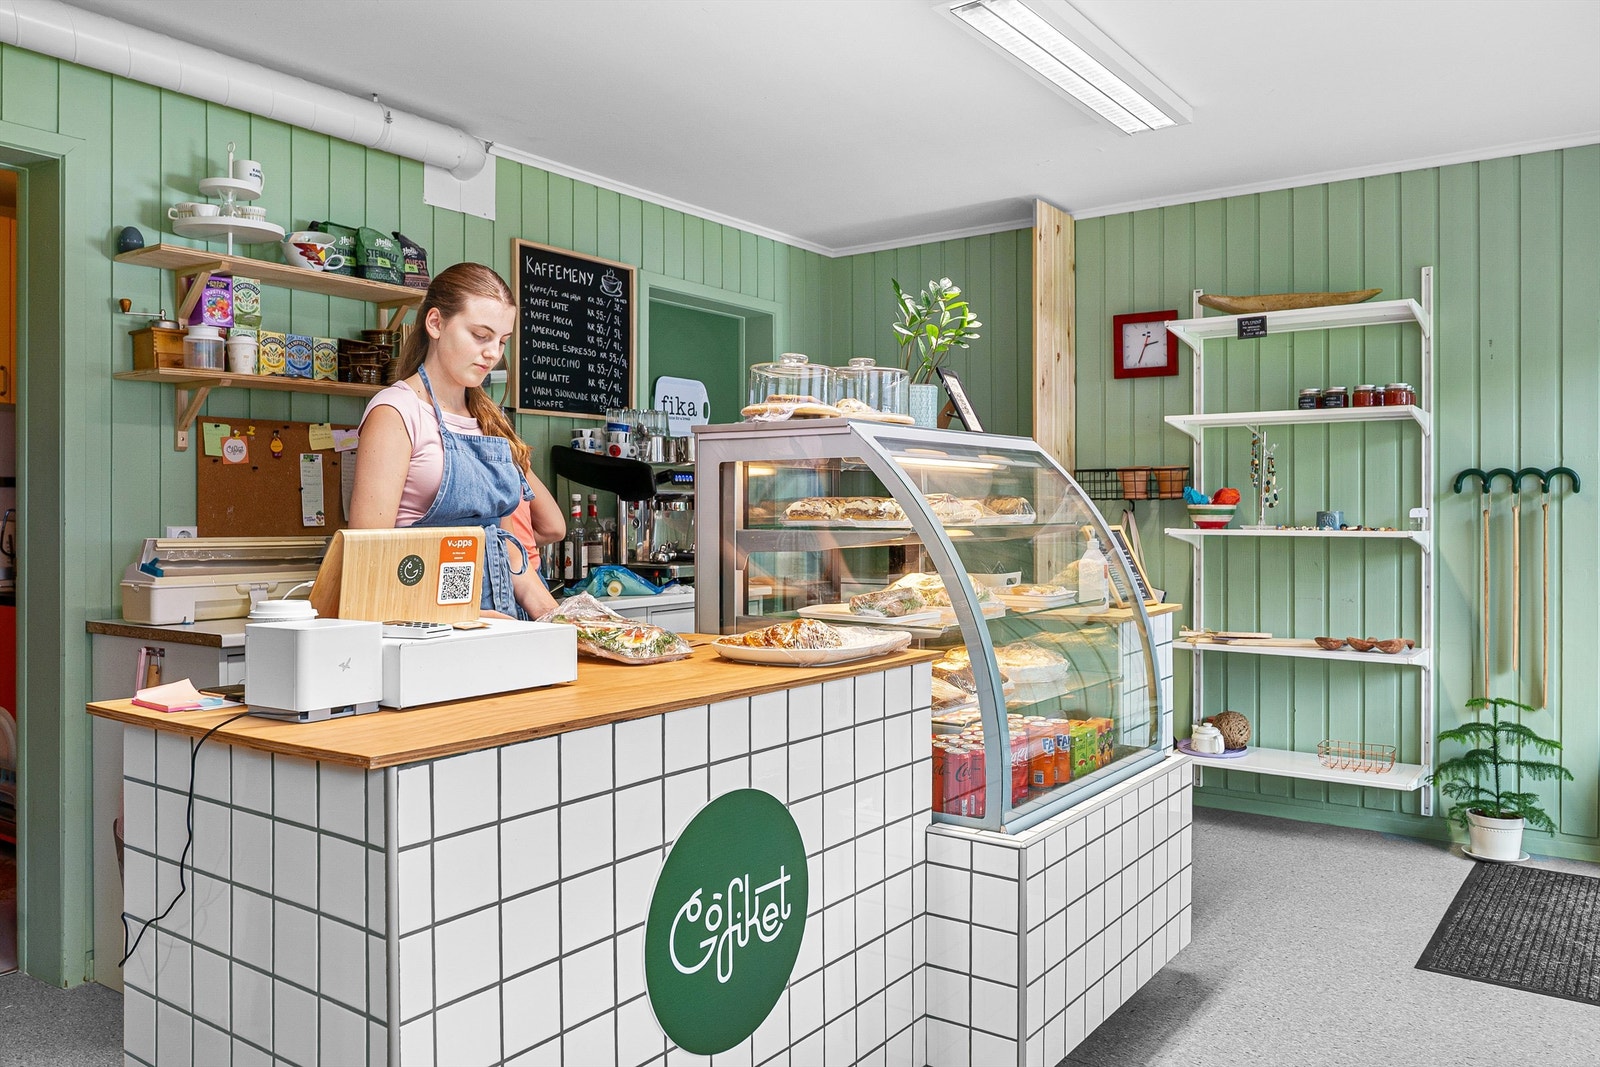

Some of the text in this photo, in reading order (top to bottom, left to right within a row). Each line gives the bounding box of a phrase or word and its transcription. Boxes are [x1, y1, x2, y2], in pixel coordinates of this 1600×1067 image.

[526, 255, 594, 286] KAFFEMENY
[530, 284, 558, 297] KAFFE/TE
[530, 297, 549, 307] KAFFE
[551, 301, 569, 311] LATTE
[587, 308, 595, 317] KR
[530, 310, 550, 321] KAFFE
[553, 315, 573, 327] MOCCA
[587, 322, 595, 331] KR
[531, 324, 570, 340] AMERICANO
[587, 335, 595, 344] KR
[532, 339, 560, 351] DOBBEL
[562, 344, 597, 357] ESPRESSO
[532, 355, 580, 369] CAPPUCCINO
[588, 363, 595, 373] KR
[531, 370, 547, 380] CHAI
[549, 373, 570, 384] LATTE
[588, 378, 596, 387] KR
[532, 386, 552, 396] VARM
[554, 388, 588, 401] SJOKOLADE
[591, 393, 599, 402] KR
[533, 400, 564, 409] ISKAFFE
[661, 395, 698, 417] fika
